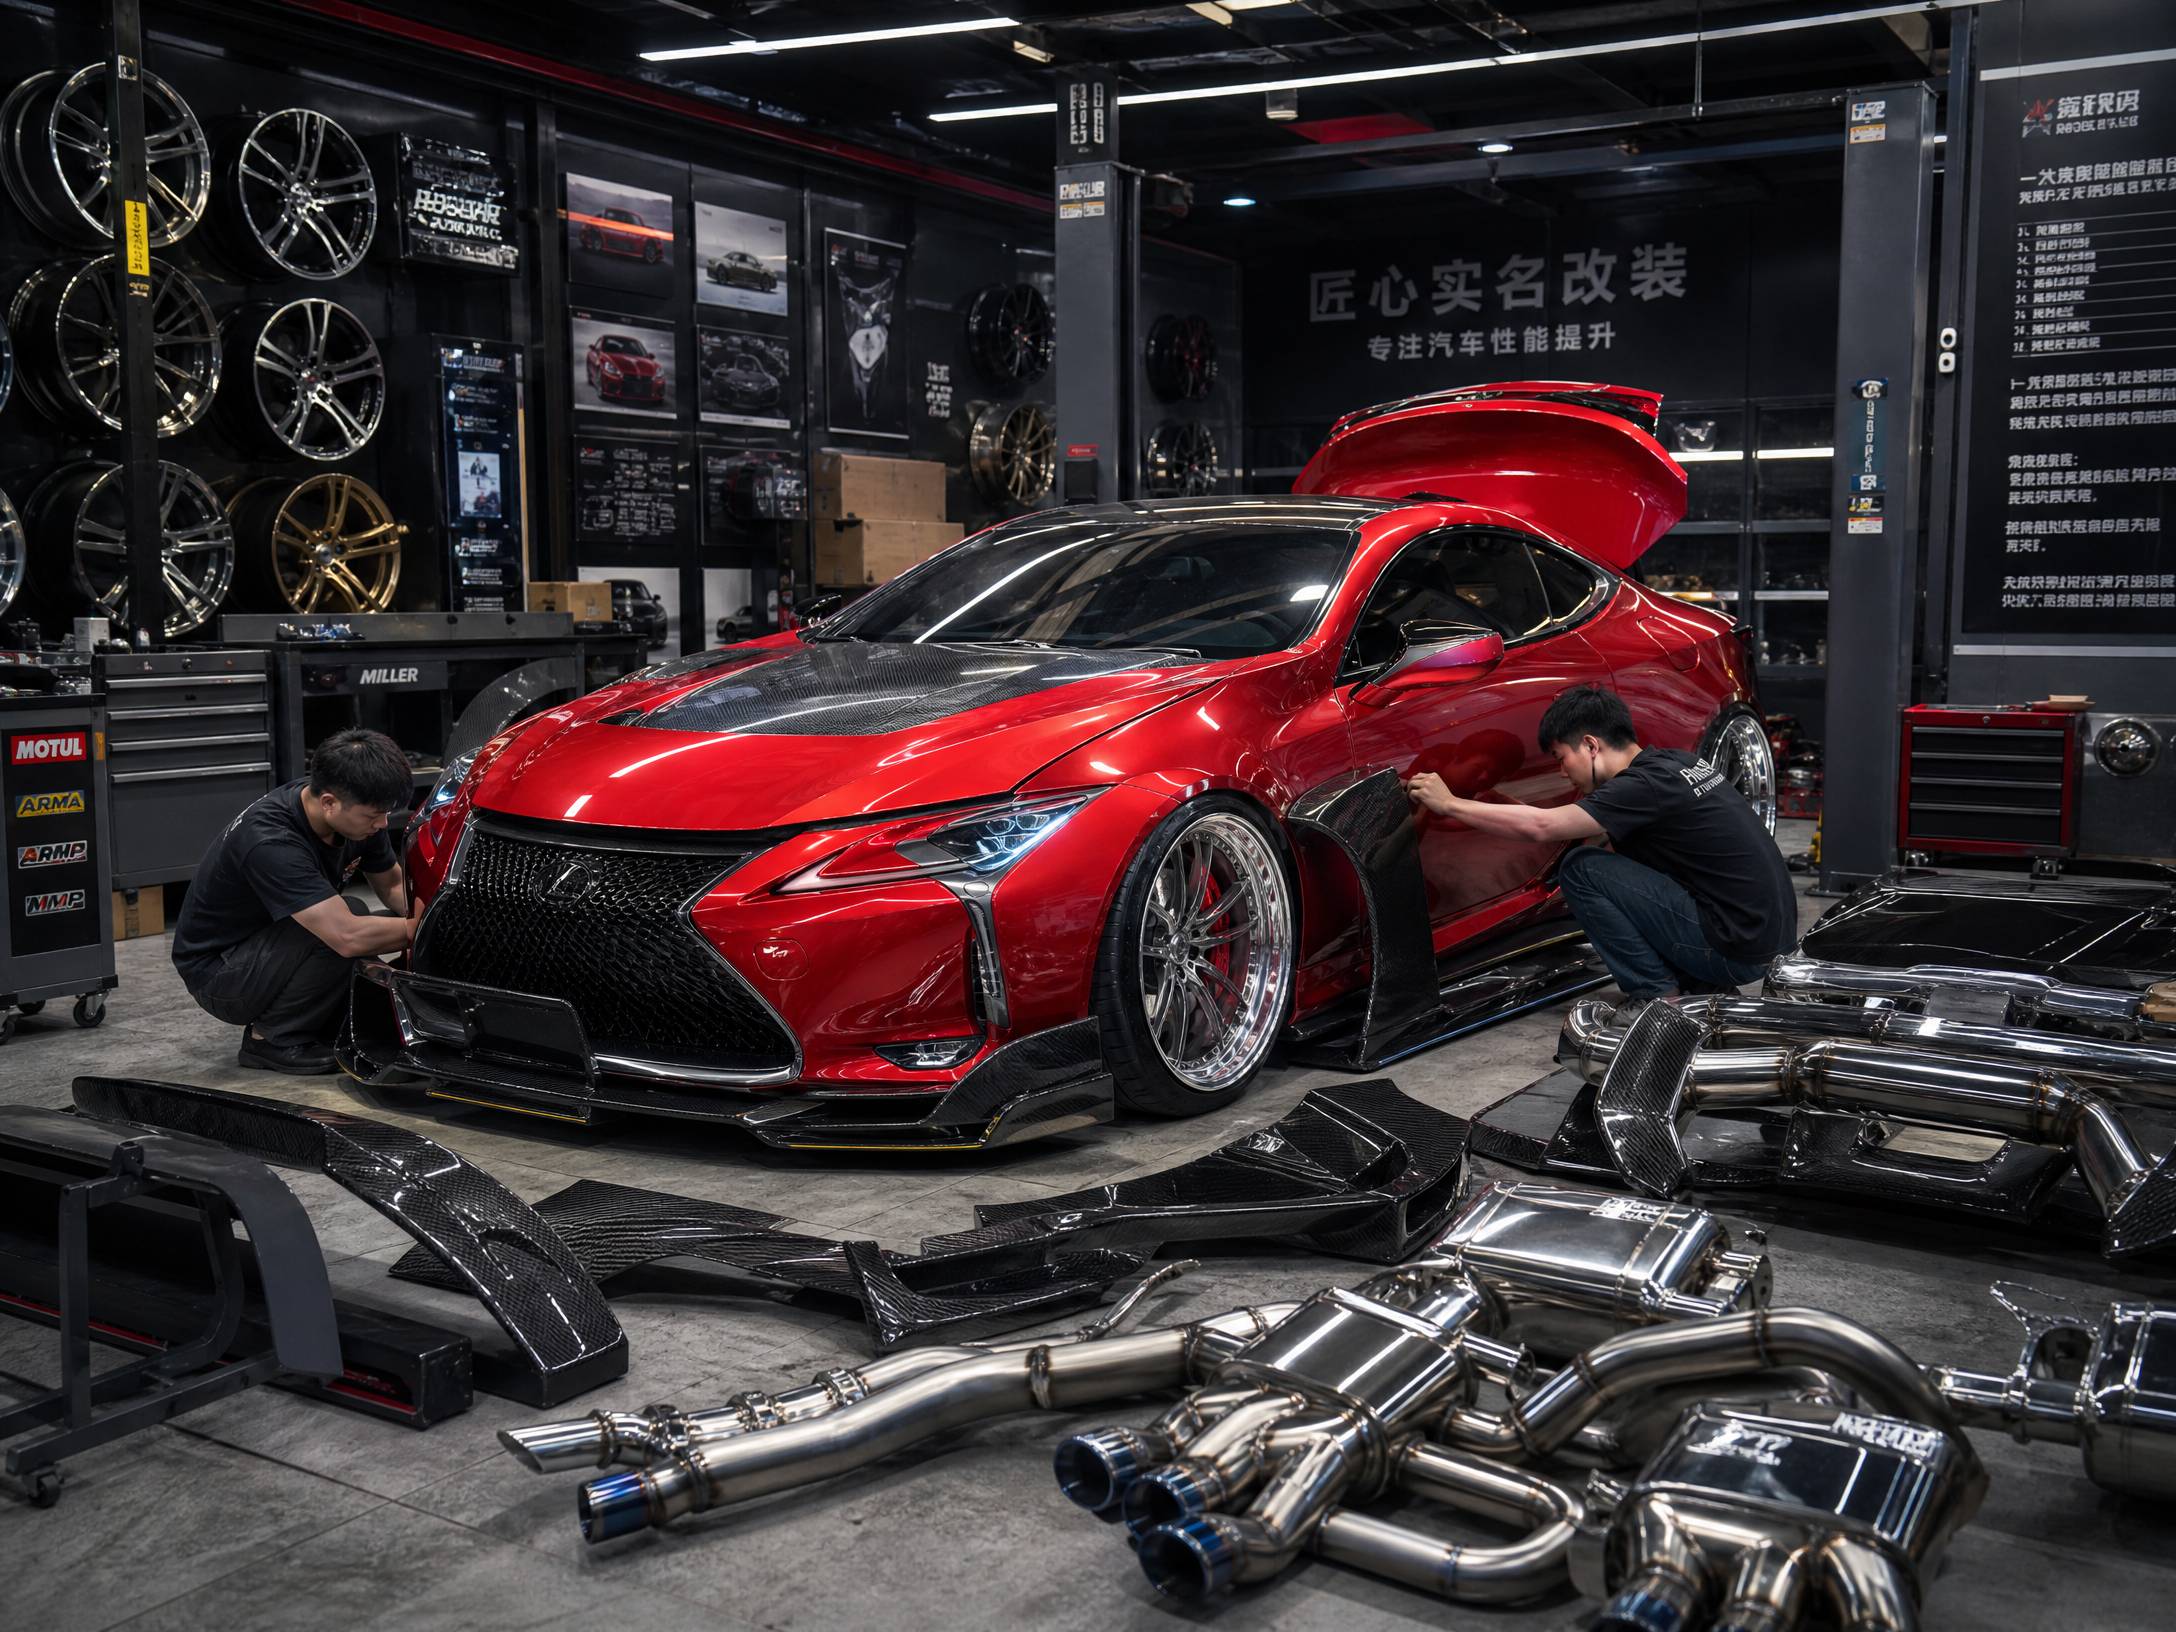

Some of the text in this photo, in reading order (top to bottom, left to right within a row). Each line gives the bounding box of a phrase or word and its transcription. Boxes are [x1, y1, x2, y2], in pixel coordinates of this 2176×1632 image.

[1309, 242, 1688, 322] 匠心实名改装
[1367, 321, 1616, 362] 专注汽车性能提升
[360, 667, 419, 685] MILLER
[15, 737, 83, 760] MOTUL
[18, 791, 84, 817] ARMA
